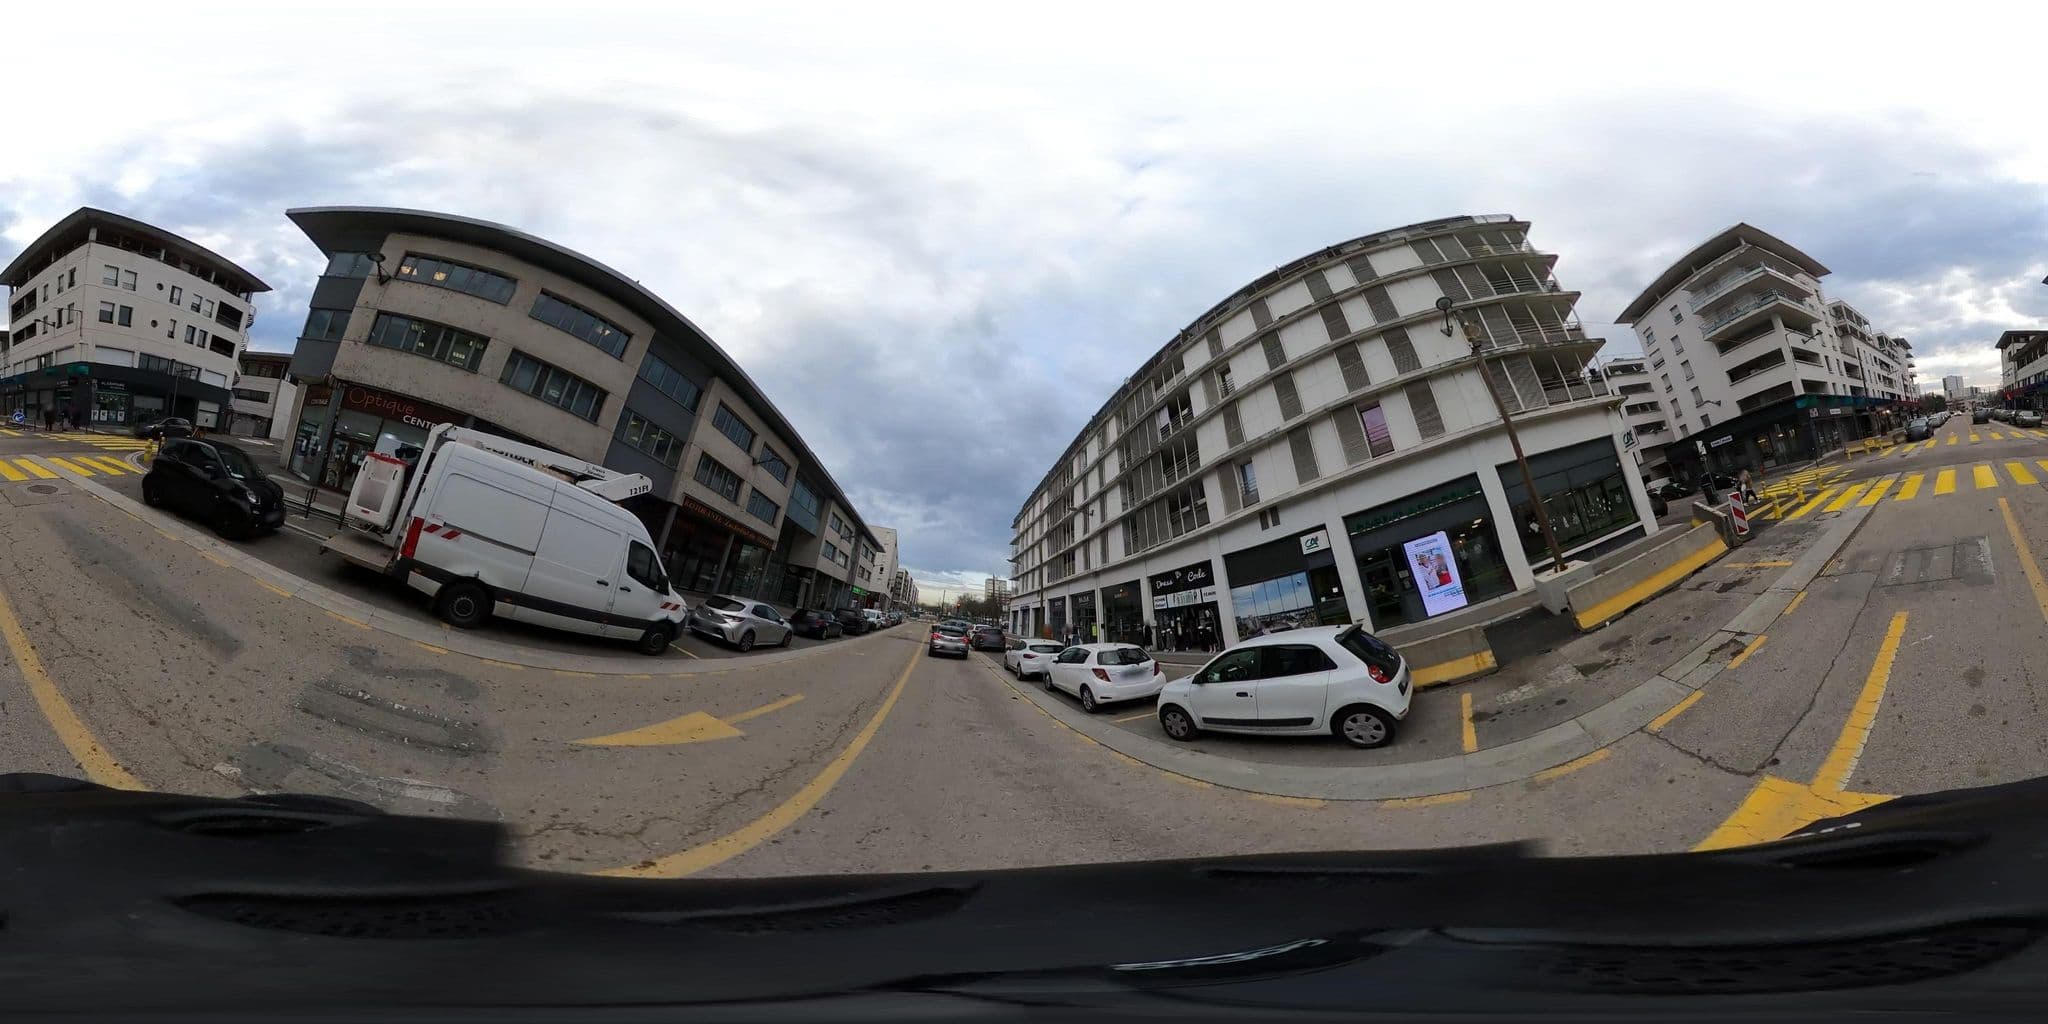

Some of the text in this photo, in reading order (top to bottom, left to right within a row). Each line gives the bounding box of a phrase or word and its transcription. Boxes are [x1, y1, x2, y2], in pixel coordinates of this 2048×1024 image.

[350, 387, 417, 415] Optique
[1156, 568, 1206, 589] Dress Code
